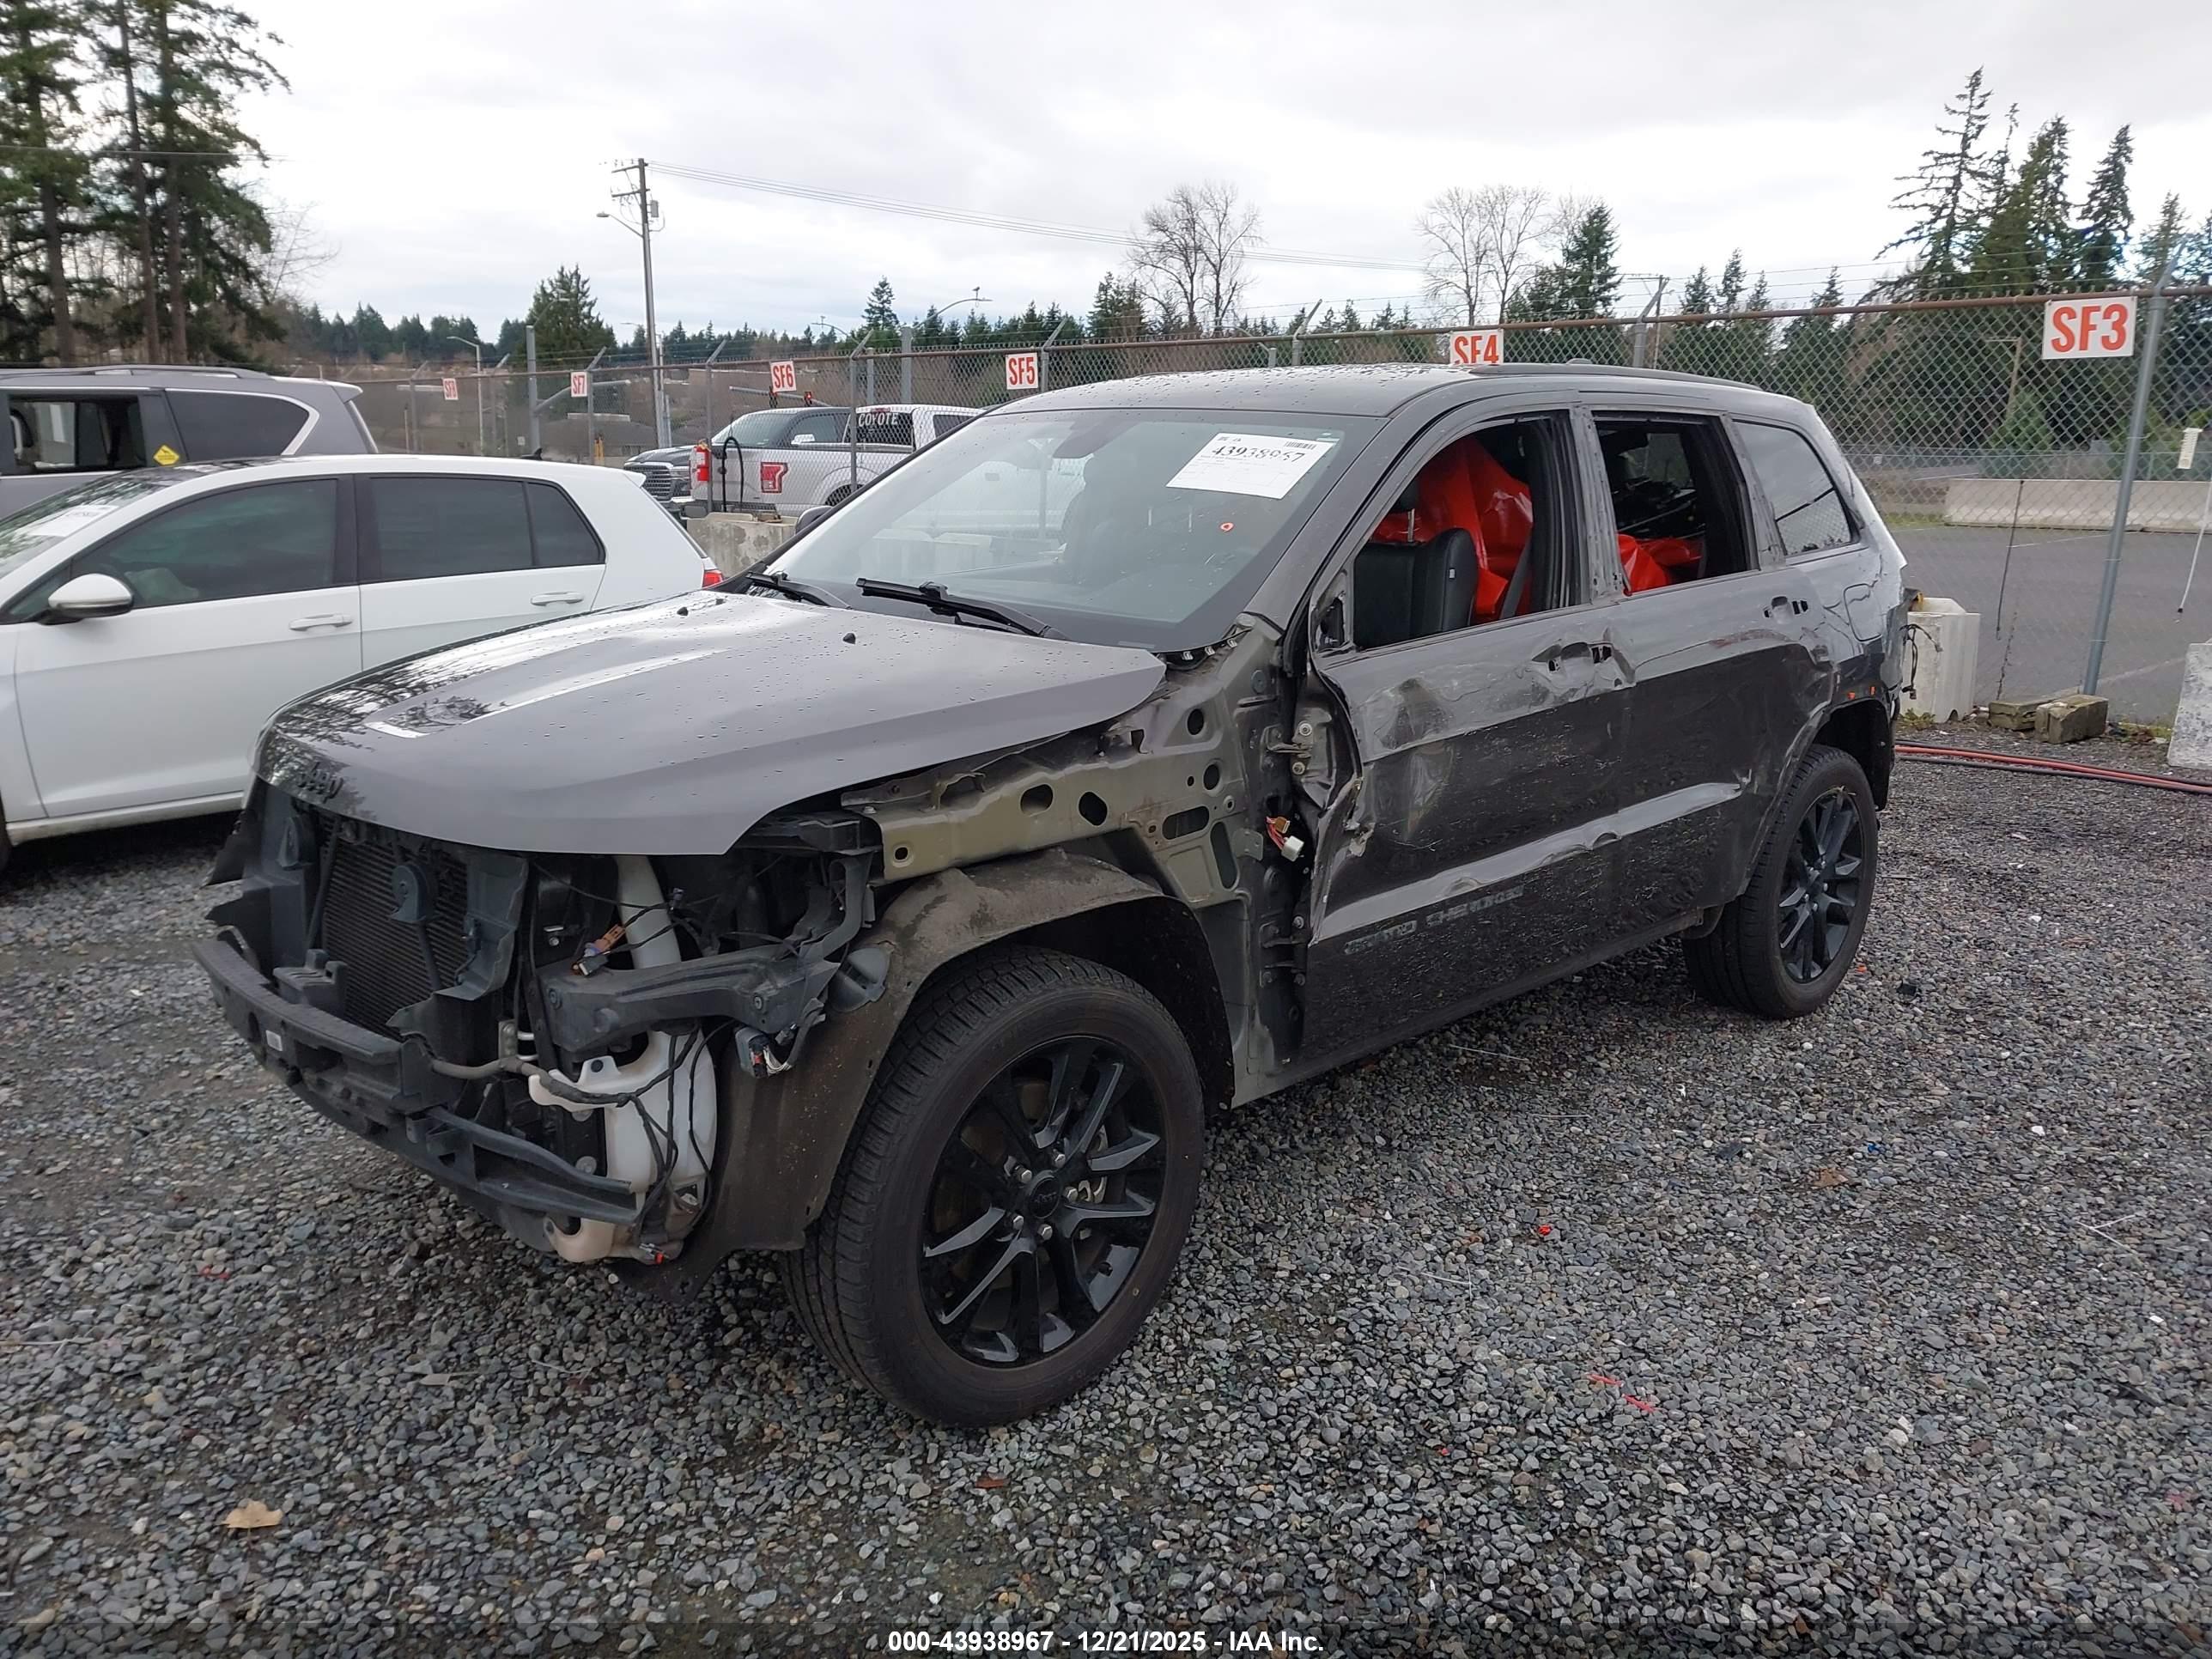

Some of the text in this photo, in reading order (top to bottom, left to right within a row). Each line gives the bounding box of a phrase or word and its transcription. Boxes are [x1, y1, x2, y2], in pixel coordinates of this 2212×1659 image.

[2051, 303, 2128, 353] SF3
[1454, 334, 1499, 364] SF4
[572, 374, 586, 395] SF7
[772, 364, 794, 388] SF6
[1008, 356, 1036, 386] SF5
[859, 411, 899, 427] COYOTE
